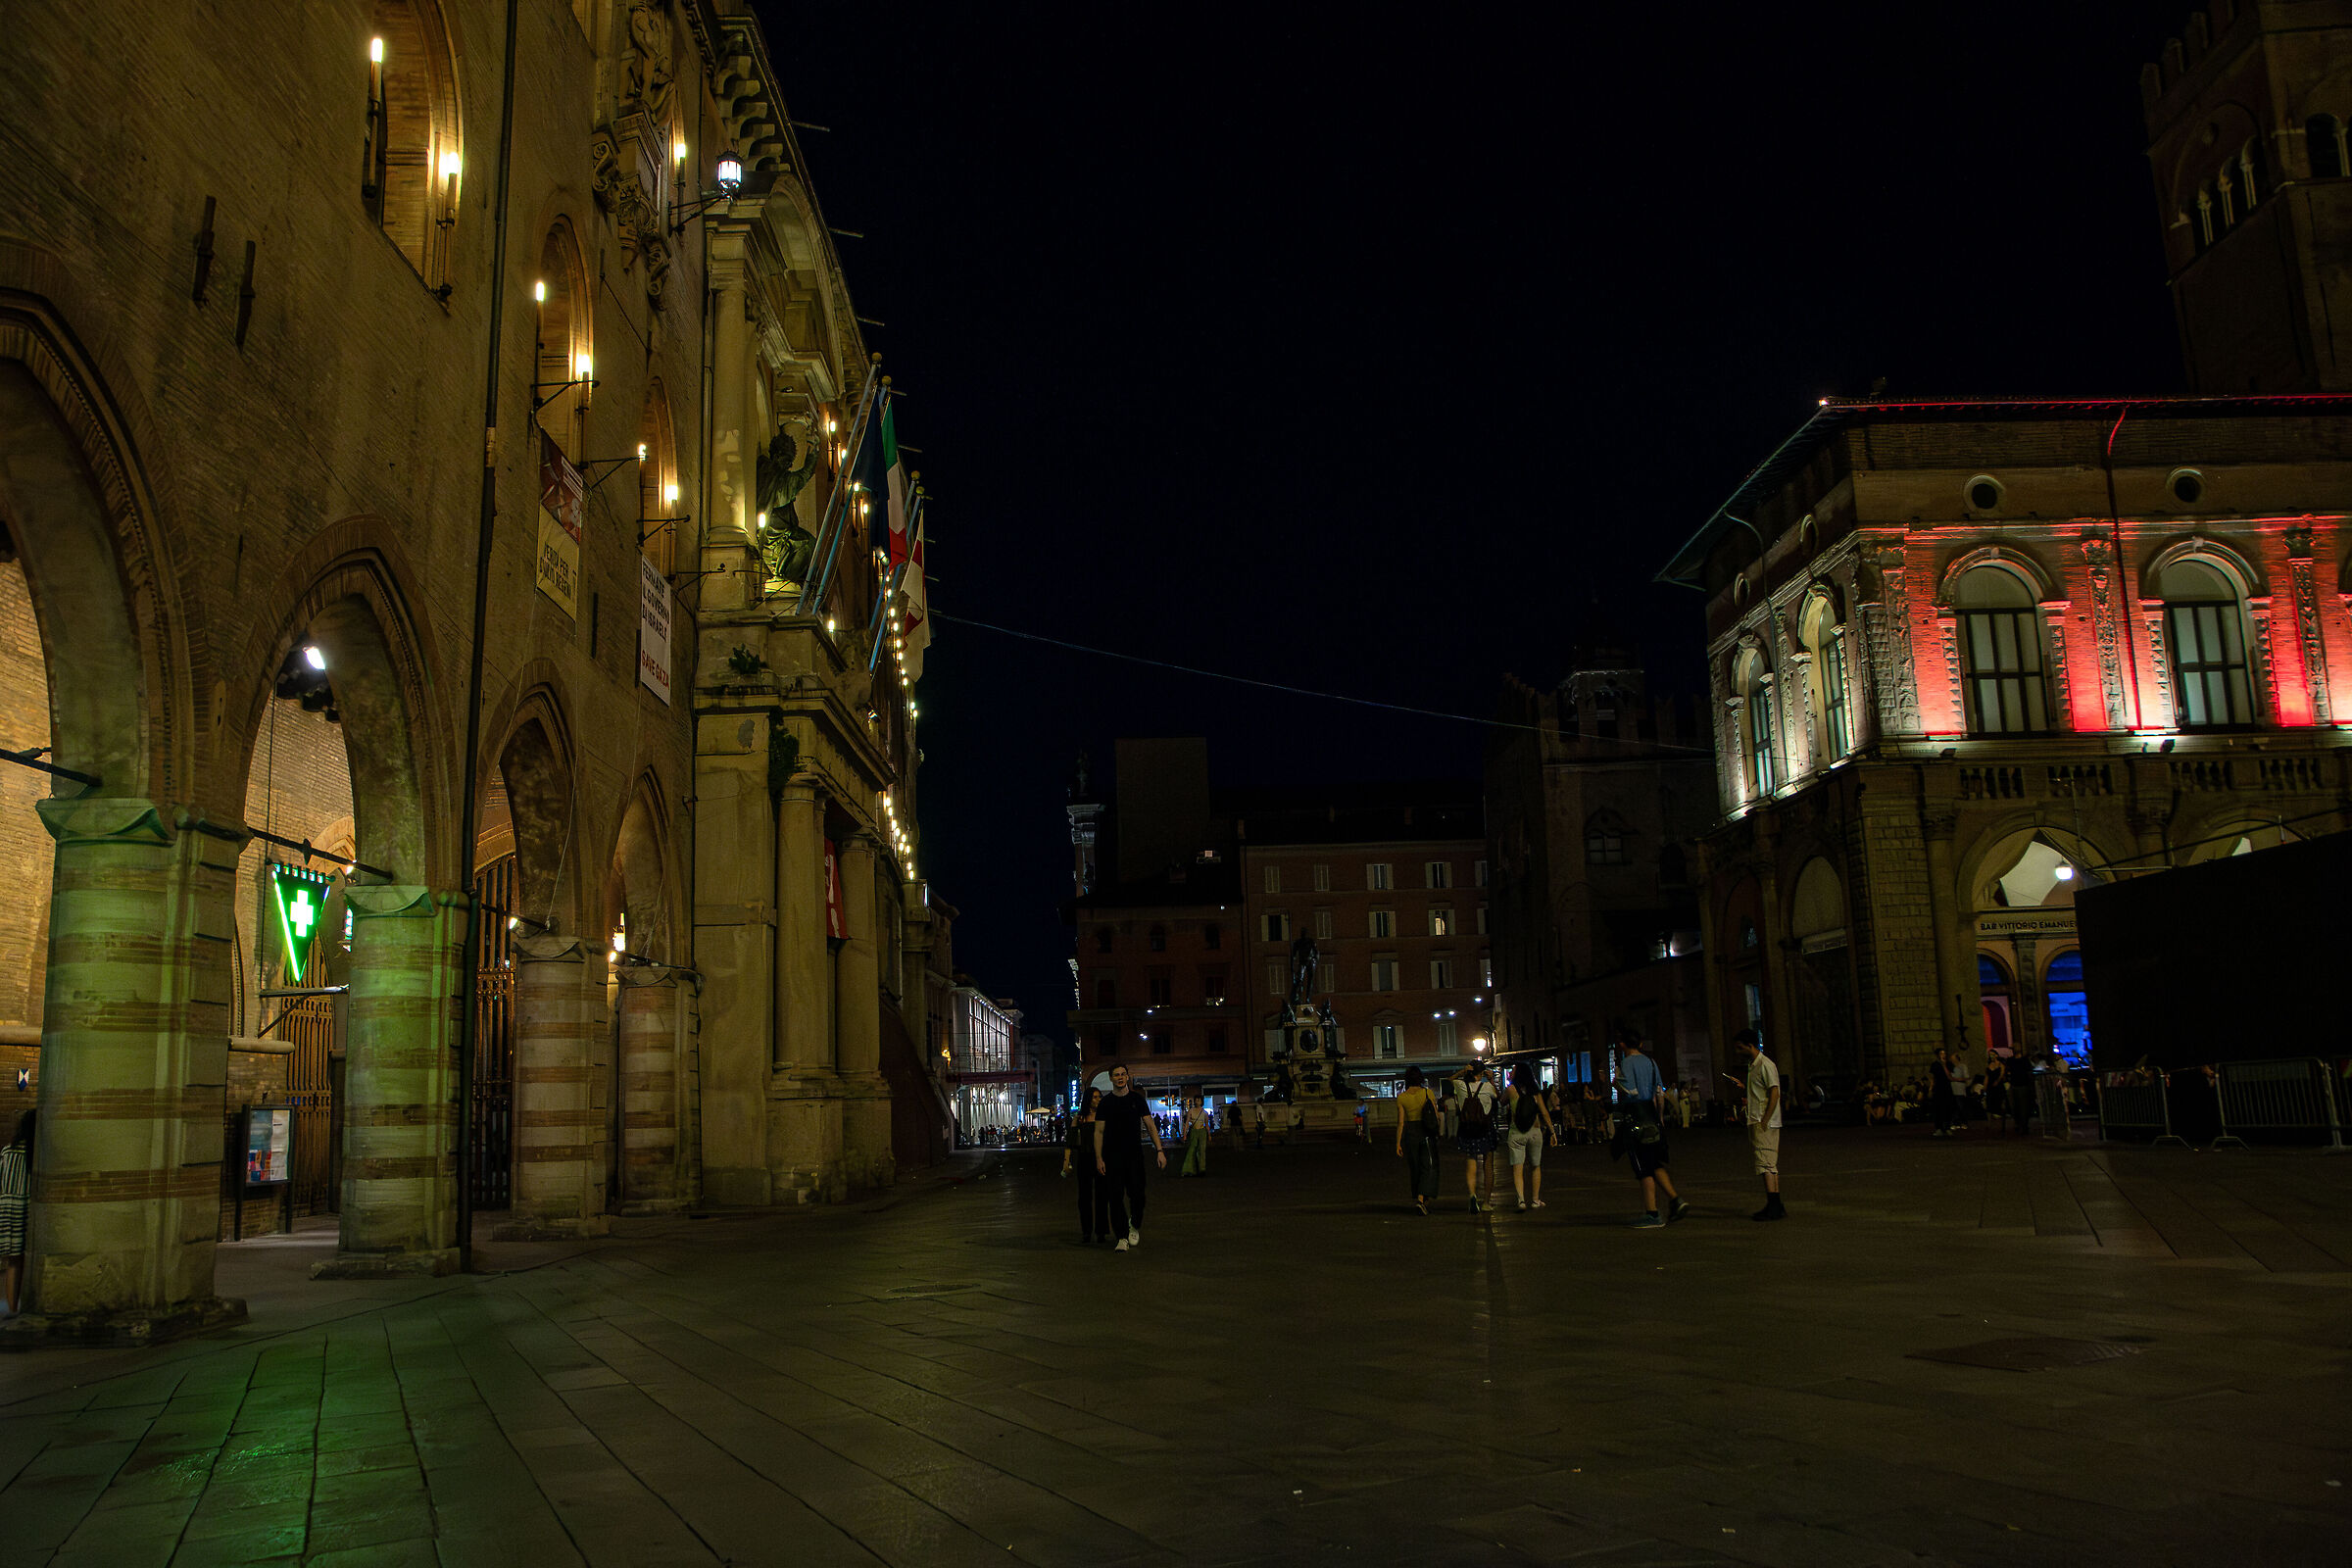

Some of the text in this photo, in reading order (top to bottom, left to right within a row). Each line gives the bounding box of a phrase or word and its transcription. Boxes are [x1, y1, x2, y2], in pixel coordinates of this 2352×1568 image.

[643, 561, 665, 599] FERMATE
[648, 588, 669, 624] GOVERNO
[642, 649, 670, 690] SAVE GAZA
[1999, 921, 2037, 930] VITTORIO
[2039, 920, 2078, 929] EMANUE
